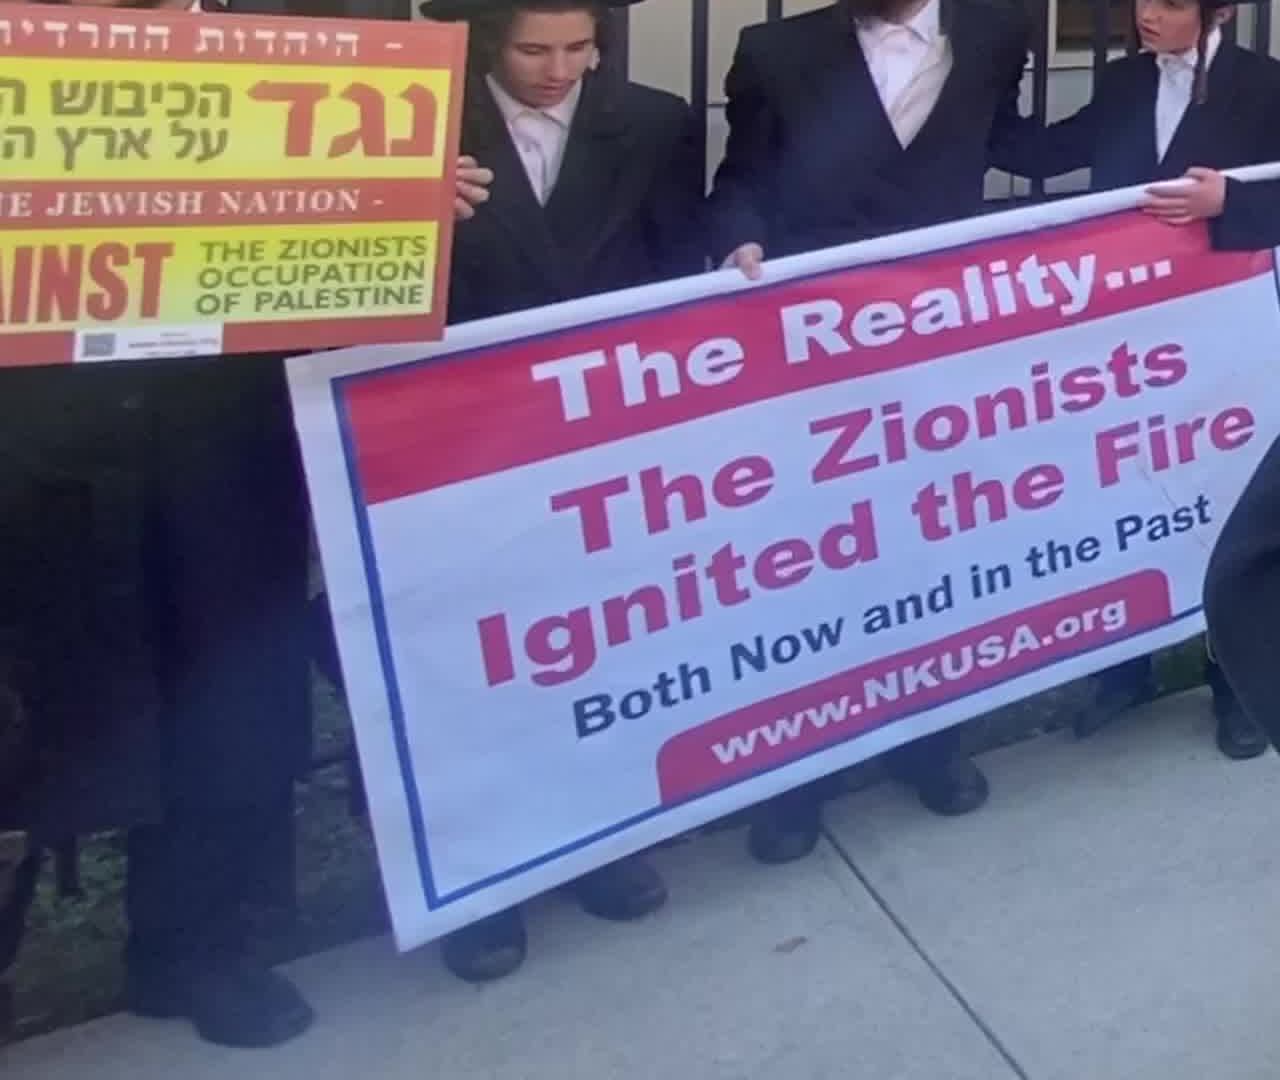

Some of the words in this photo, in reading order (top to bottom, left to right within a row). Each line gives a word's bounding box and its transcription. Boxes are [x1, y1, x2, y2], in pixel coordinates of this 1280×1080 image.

[195, 26, 360, 57] היהדות
[50, 80, 231, 119] הכיבוש
[247, 80, 438, 158] נגד
[56, 126, 152, 171] ארץ
[170, 121, 228, 162] על
[46, 191, 203, 217] JEWISH
[218, 189, 360, 214] NATION
[203, 241, 266, 263] THE
[279, 236, 427, 260] ZIONISTS
[199, 261, 425, 289] OCCUPATION
[195, 293, 241, 316] OF
[253, 284, 423, 311] PALESTINE
[531, 343, 746, 423] The
[780, 248, 1175, 363] Reality...
[551, 455, 775, 555] The
[808, 335, 1188, 486] Zionists
[475, 500, 879, 689] Ignited
[911, 461, 1064, 546] the
[1094, 404, 1257, 489] Fire
[572, 660, 712, 742] Both
[729, 614, 846, 684] Now
[861, 574, 955, 636] and
[969, 561, 1014, 599] in
[1025, 532, 1102, 581] the
[1115, 493, 1213, 556] Past
[710, 595, 1131, 767] www.NKUSA.org
